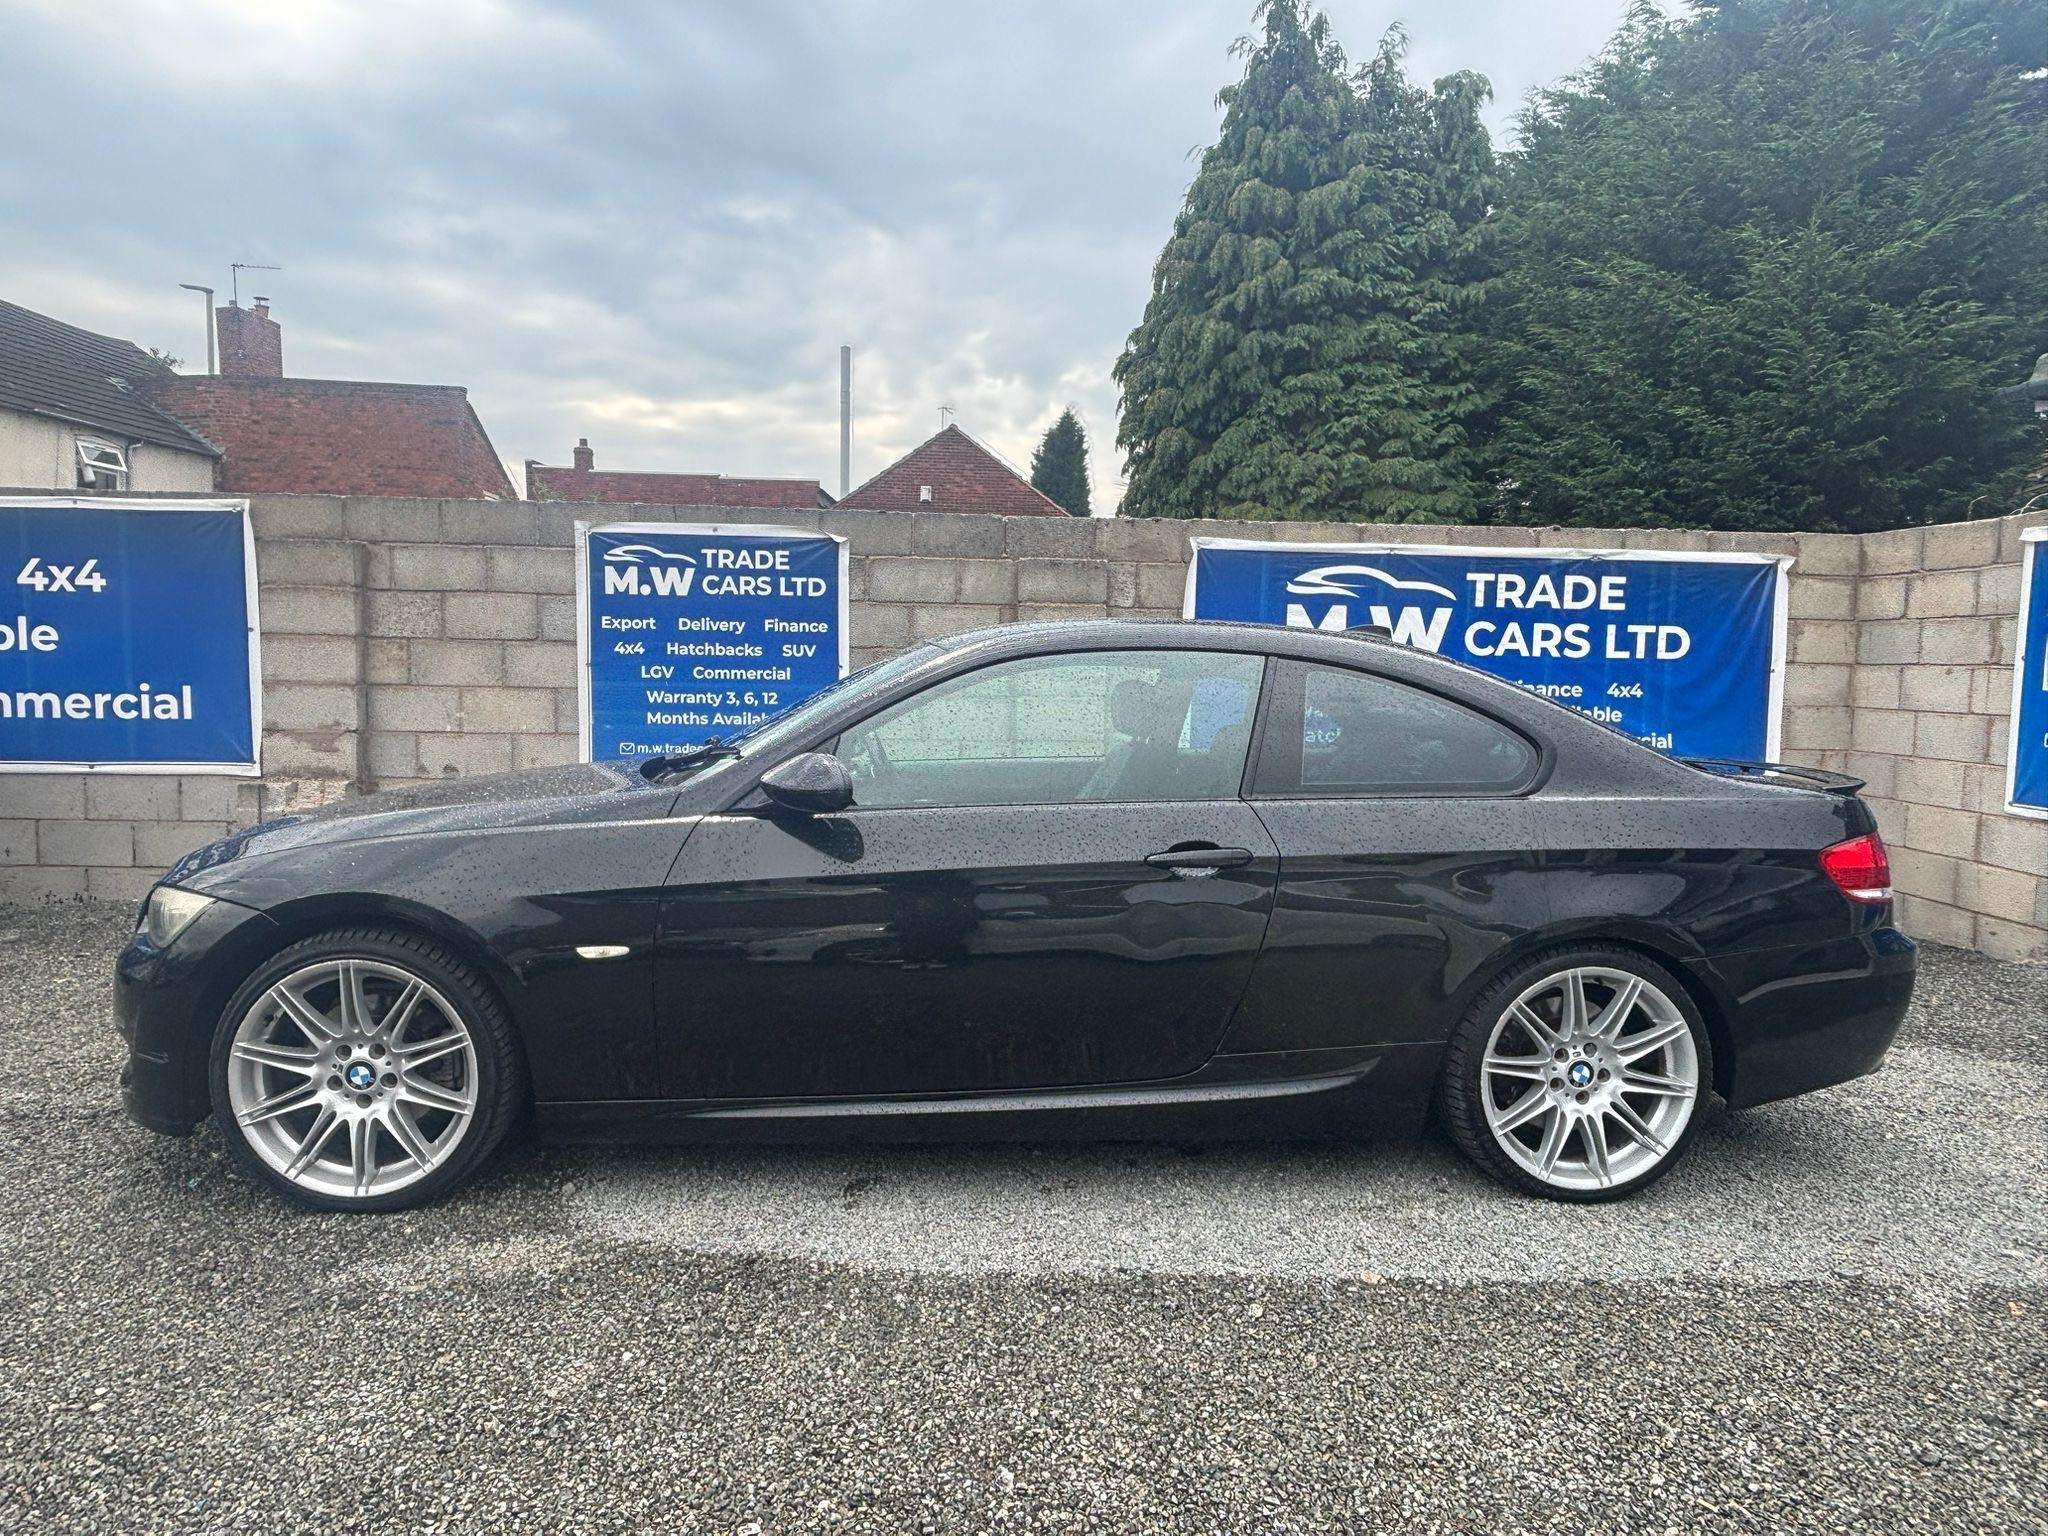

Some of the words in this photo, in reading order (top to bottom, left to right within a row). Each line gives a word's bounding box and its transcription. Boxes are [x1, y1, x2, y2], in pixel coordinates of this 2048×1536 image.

[701, 549, 790, 571] TRADE
[16, 557, 107, 593] 4x4
[604, 565, 696, 597] M.W
[702, 575, 772, 597] CARS
[779, 577, 827, 597] LTD
[1466, 573, 1627, 611] TRADE
[601, 616, 656, 632] Export
[678, 617, 746, 635] Delivery
[764, 618, 828, 633] Finance
[614, 641, 645, 655] 4x4
[666, 643, 763, 657] Hatchbacks
[782, 644, 817, 658] SUV
[1464, 621, 1591, 659] CARS
[1605, 624, 1691, 660] LTD
[641, 665, 675, 679] LGV
[692, 667, 791, 681] Commercial
[646, 690, 722, 707] Warranty
[726, 691, 740, 707] 3,
[743, 692, 759, 707] 6,
[762, 692, 779, 705] 12
[1606, 682, 1644, 698] 4x4
[0, 683, 193, 720] mercial
[646, 711, 709, 725] Months
